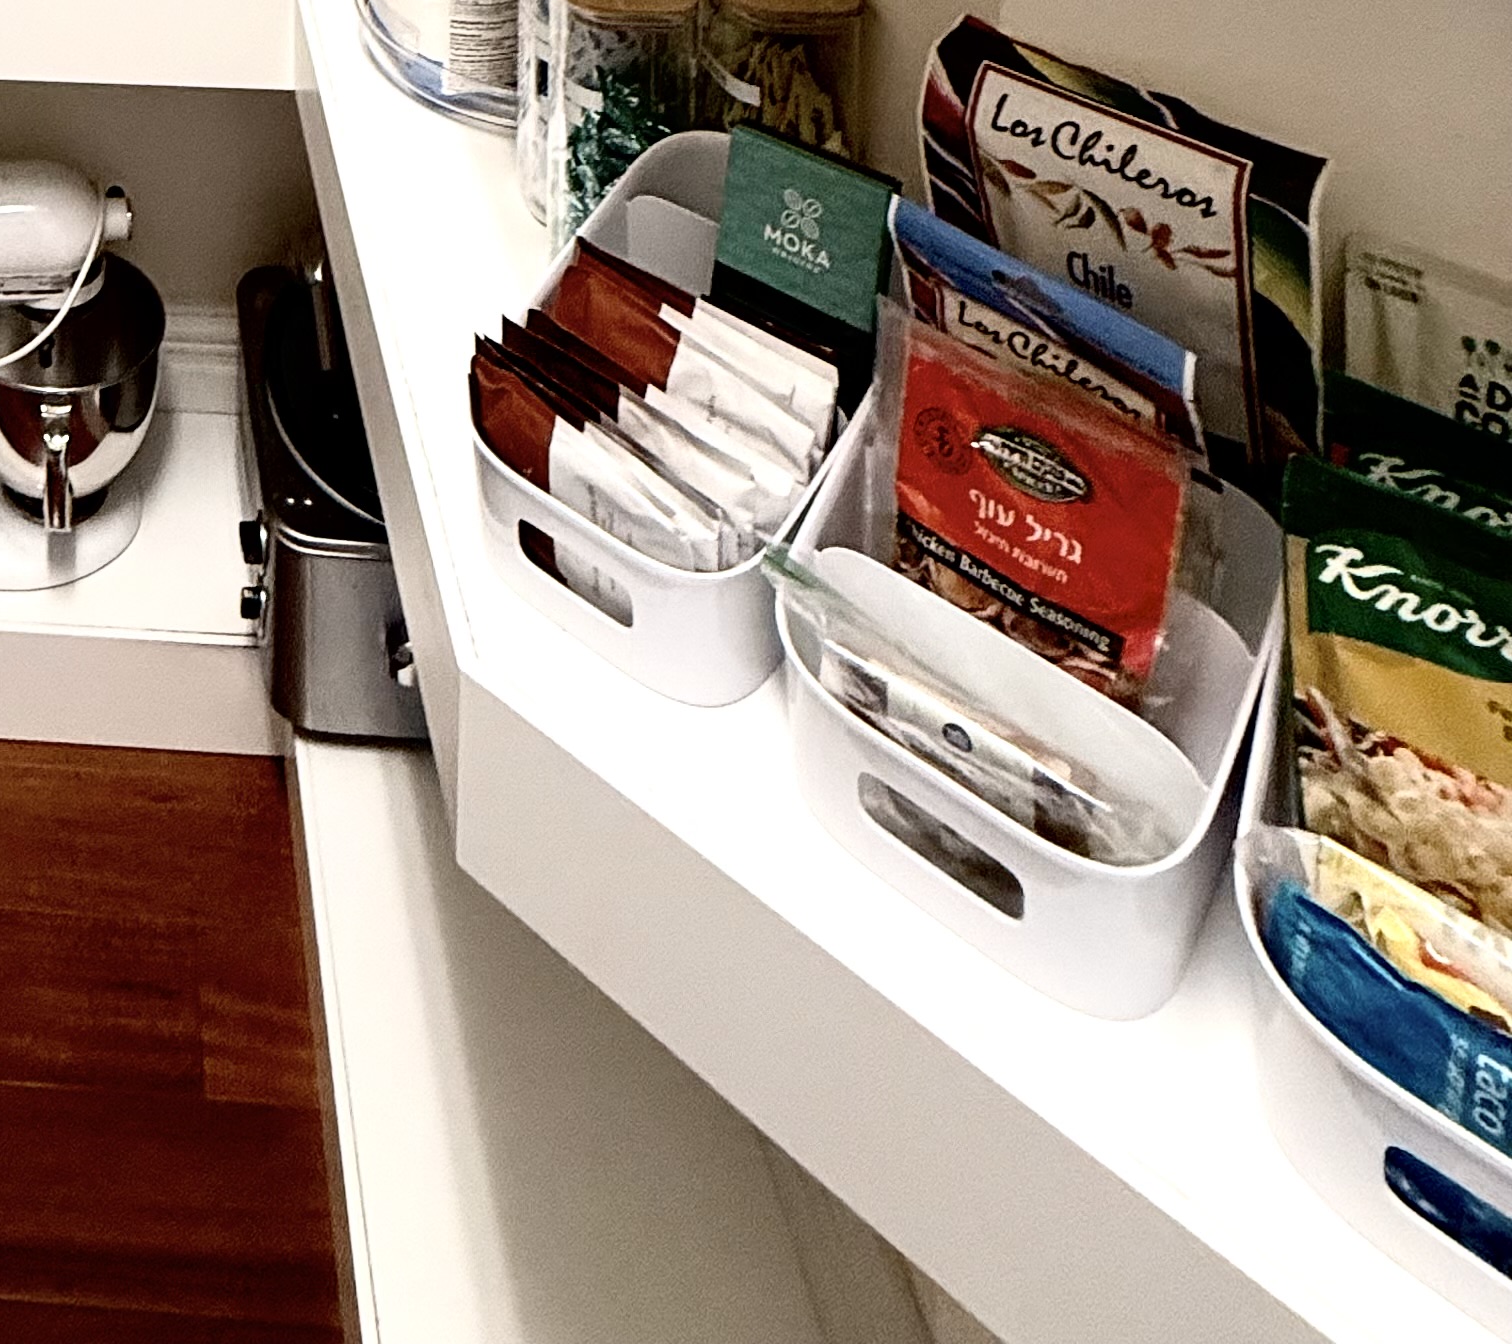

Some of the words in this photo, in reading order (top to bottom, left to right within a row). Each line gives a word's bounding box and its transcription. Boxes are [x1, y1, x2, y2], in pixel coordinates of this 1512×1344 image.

[990, 93, 1046, 148] Los
[1050, 120, 1218, 219] Chileros
[763, 223, 831, 269] MOKA
[1065, 250, 1134, 309] Chile
[957, 300, 1002, 339] Los
[1006, 330, 1141, 417] Chileros
[967, 488, 1017, 528] עוף
[1024, 513, 1083, 565] גריל
[900, 520, 956, 564] hicken
[958, 553, 1026, 608] Barbecue
[1028, 595, 1112, 654] Seasoning
[1471, 1053, 1512, 1138] taco
